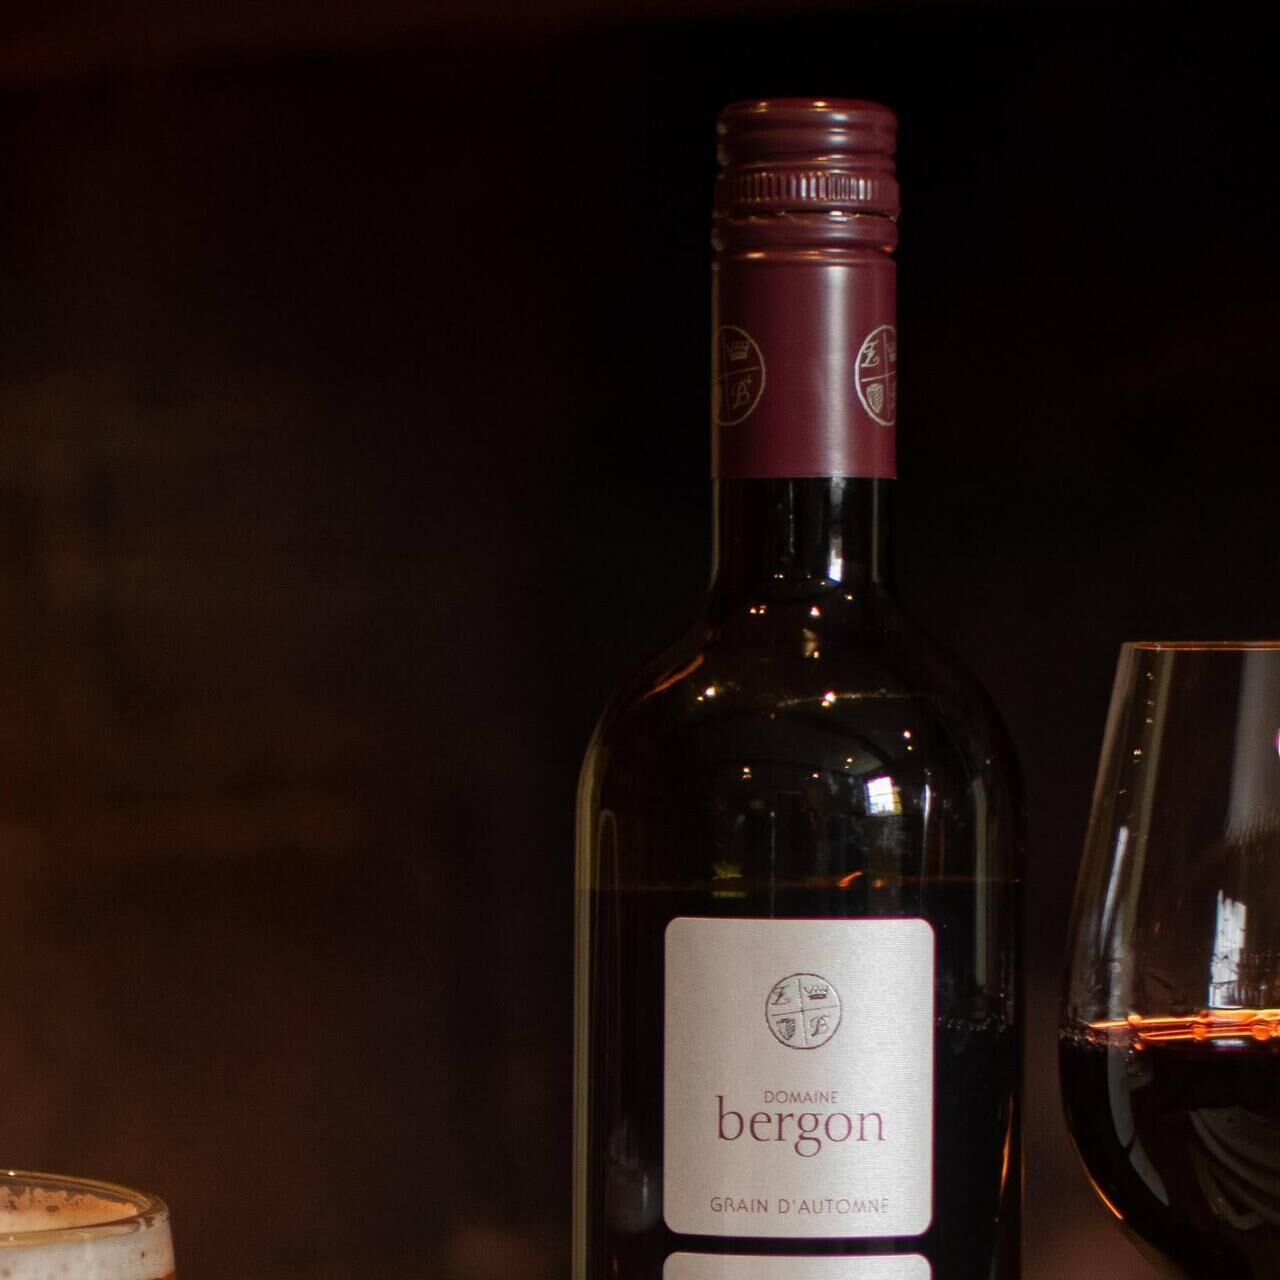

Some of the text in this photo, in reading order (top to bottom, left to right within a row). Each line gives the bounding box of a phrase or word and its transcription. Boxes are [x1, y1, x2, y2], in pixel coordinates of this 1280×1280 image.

[764, 1090, 839, 1104] DOMAINE
[715, 1095, 886, 1158] bergon
[710, 1196, 890, 1214] GRAIN D'AUTOMNE
